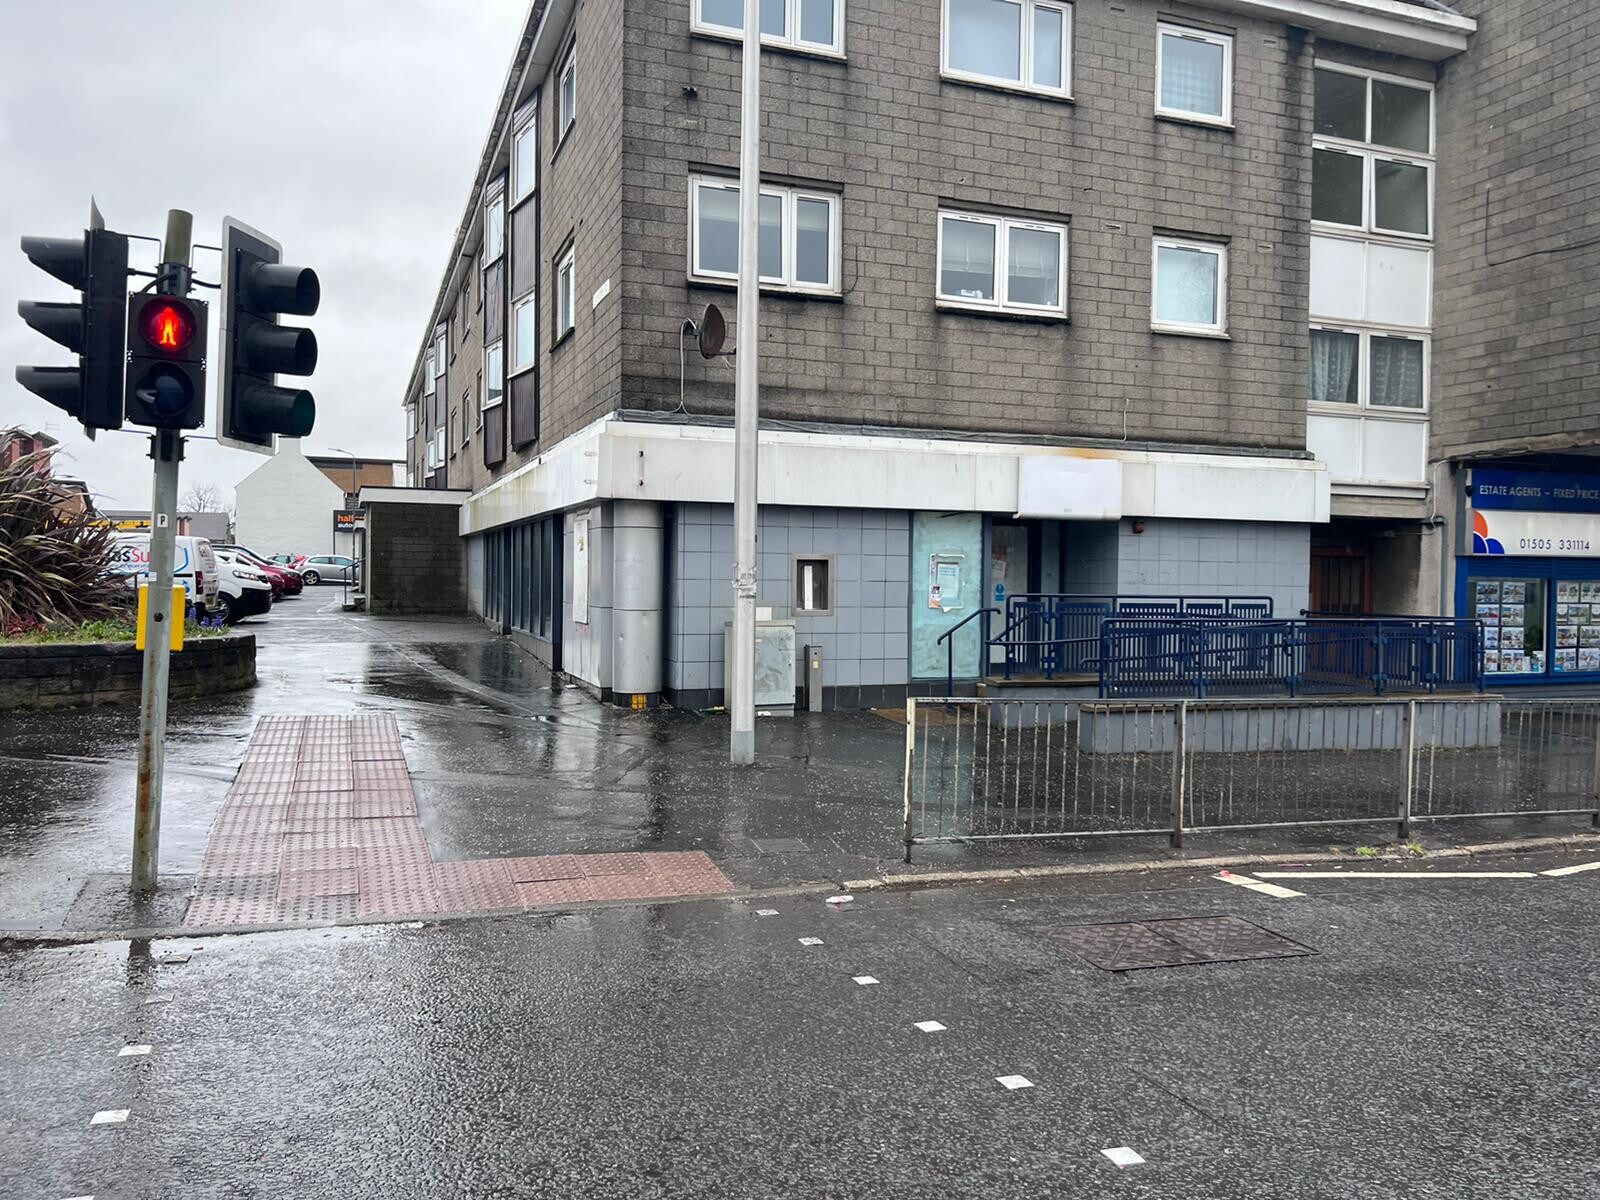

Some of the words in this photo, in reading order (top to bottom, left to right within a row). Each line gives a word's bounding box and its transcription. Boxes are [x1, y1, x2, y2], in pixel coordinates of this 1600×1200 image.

[1480, 485, 1507, 496] ESTATE
[1509, 486, 1541, 497] AGENTS
[1553, 488, 1575, 499] FIXED
[1577, 489, 1599, 500] PRICE
[160, 515, 166, 525] P
[1520, 538, 1552, 550] 01505
[1559, 539, 1590, 550] 331114
